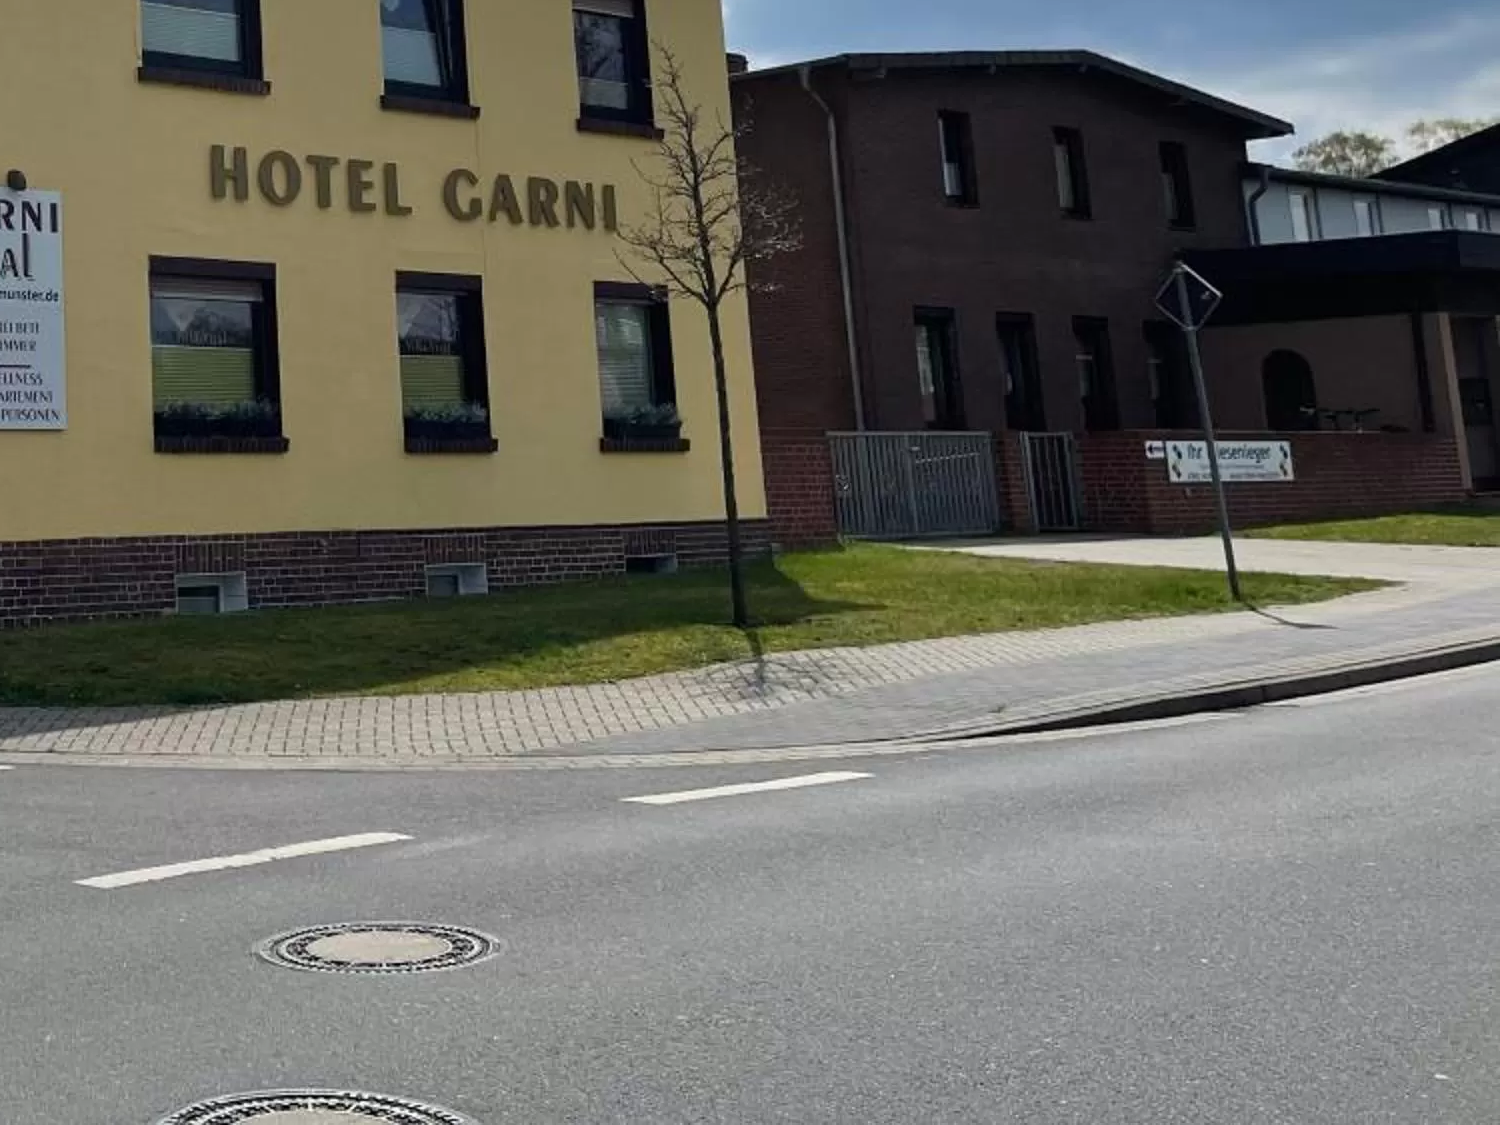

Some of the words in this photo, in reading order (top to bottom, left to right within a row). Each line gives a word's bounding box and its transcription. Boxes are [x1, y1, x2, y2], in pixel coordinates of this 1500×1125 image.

[208, 144, 413, 217] HOTEL
[442, 168, 618, 232] GARNI
[1, 408, 60, 421] PERSONEN
